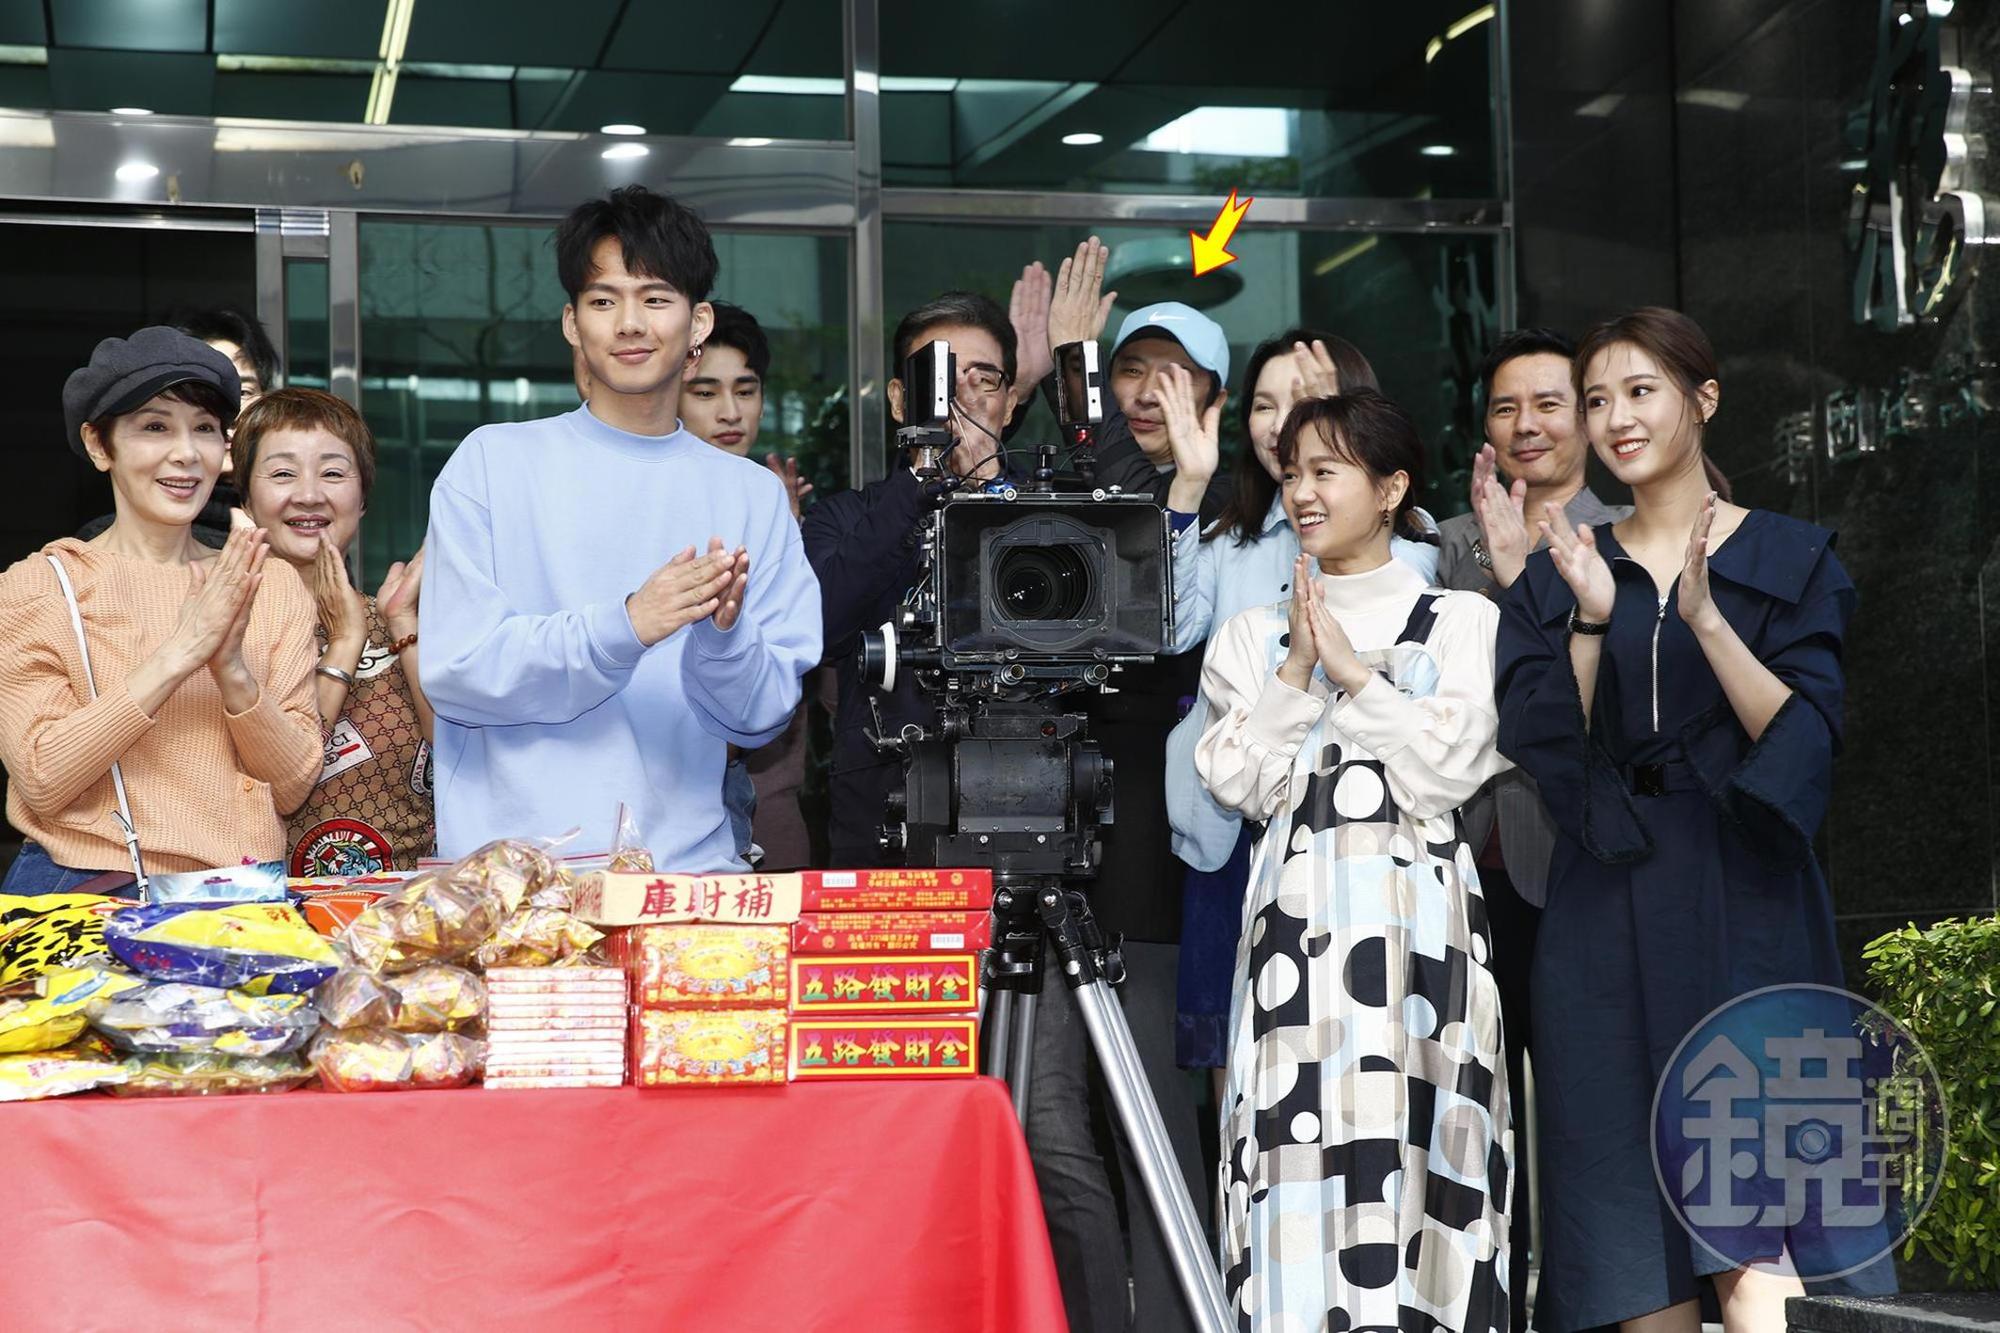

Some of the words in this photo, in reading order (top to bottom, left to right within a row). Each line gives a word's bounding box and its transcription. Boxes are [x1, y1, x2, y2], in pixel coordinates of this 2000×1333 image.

[801, 964, 969, 1001] 五路發財金
[801, 1027, 969, 1066] 五路發財金
